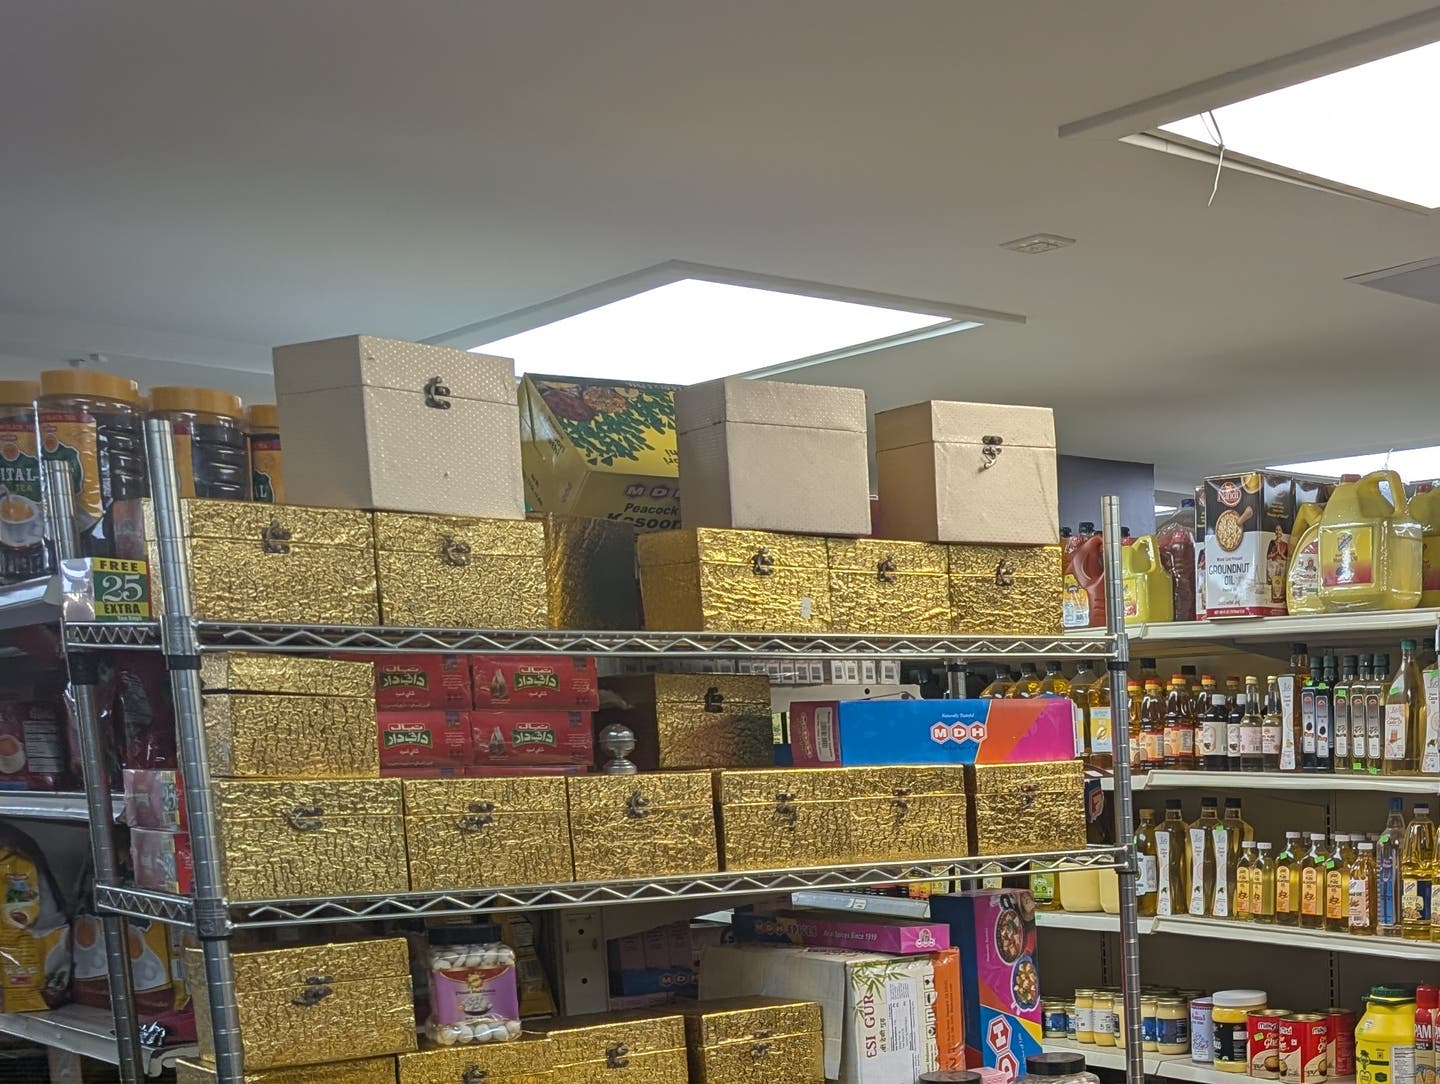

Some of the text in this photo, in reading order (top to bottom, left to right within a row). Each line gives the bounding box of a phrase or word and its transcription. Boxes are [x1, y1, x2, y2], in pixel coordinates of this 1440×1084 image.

[624, 503, 679, 516] Peacock
[100, 560, 138, 572] FREE
[1208, 562, 1251, 576] GROUNDNUT
[1223, 574, 1236, 587] OIL
[102, 575, 143, 601] 25
[104, 603, 141, 614] EXTRA
[931, 725, 986, 741] MDH
[864, 993, 876, 1028] GUR
[1414, 1024, 1432, 1039] PAM
[866, 1035, 877, 1059] ESI
